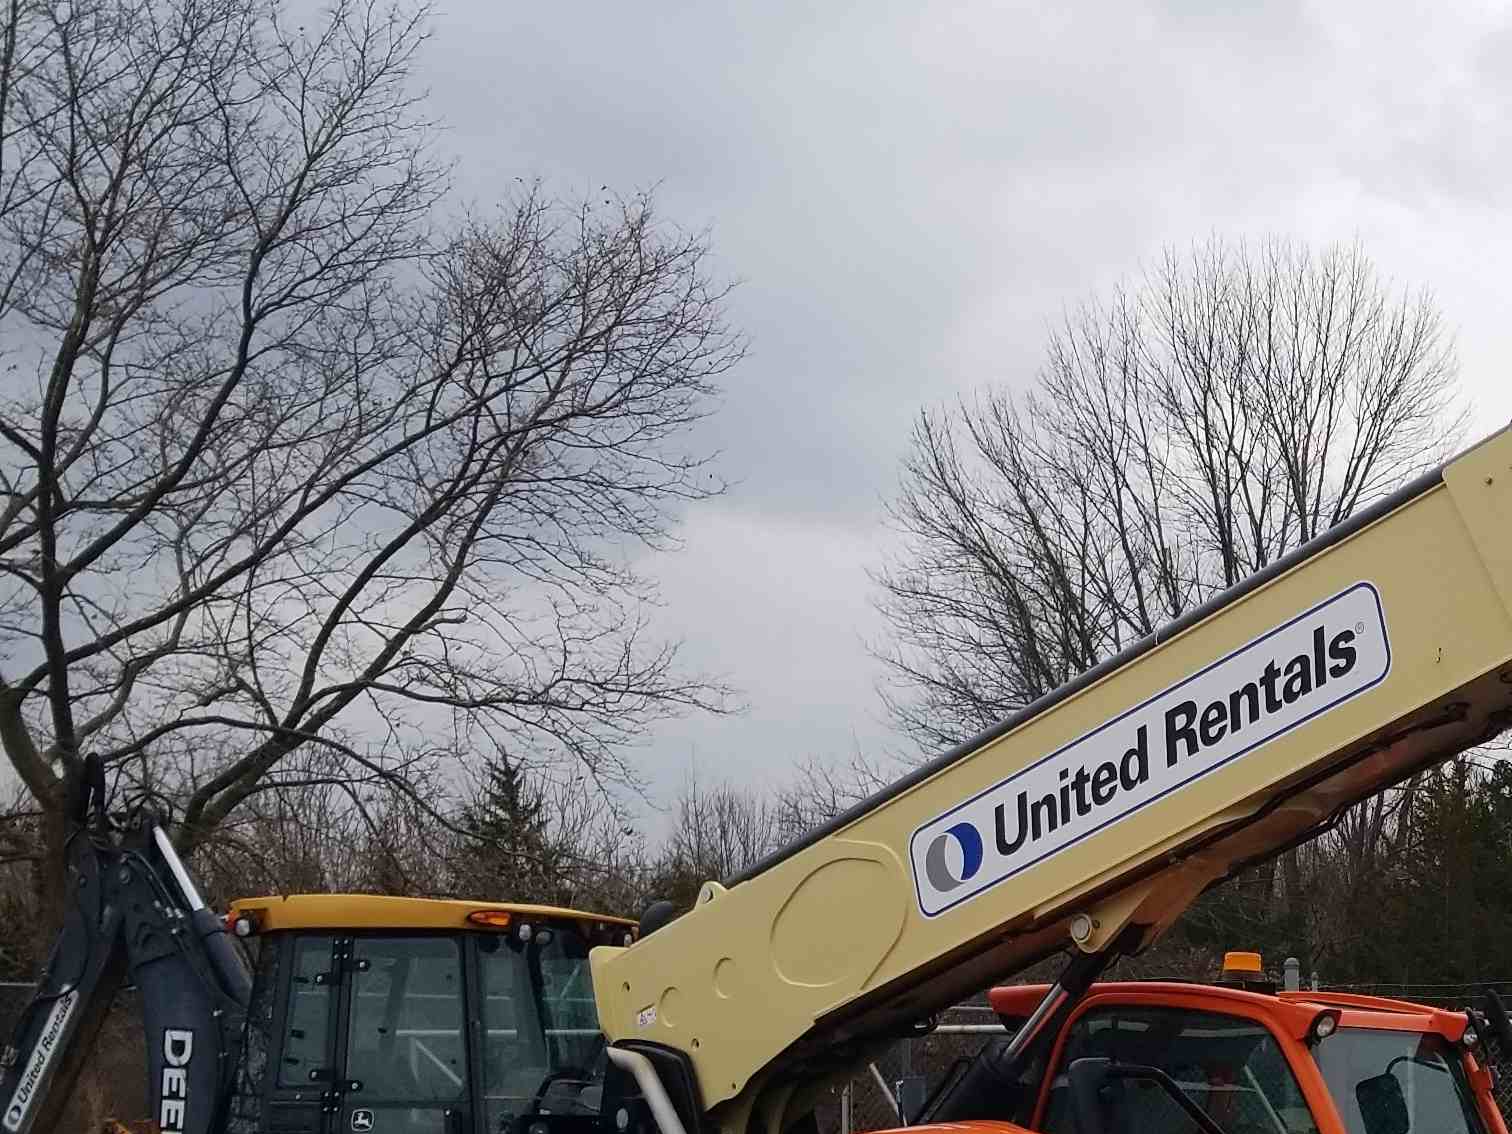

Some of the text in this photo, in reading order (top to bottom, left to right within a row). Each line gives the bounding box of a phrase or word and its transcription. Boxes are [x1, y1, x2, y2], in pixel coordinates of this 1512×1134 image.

[995, 625, 1357, 856] United Rentals
[17, 991, 73, 1104] United Rentals
